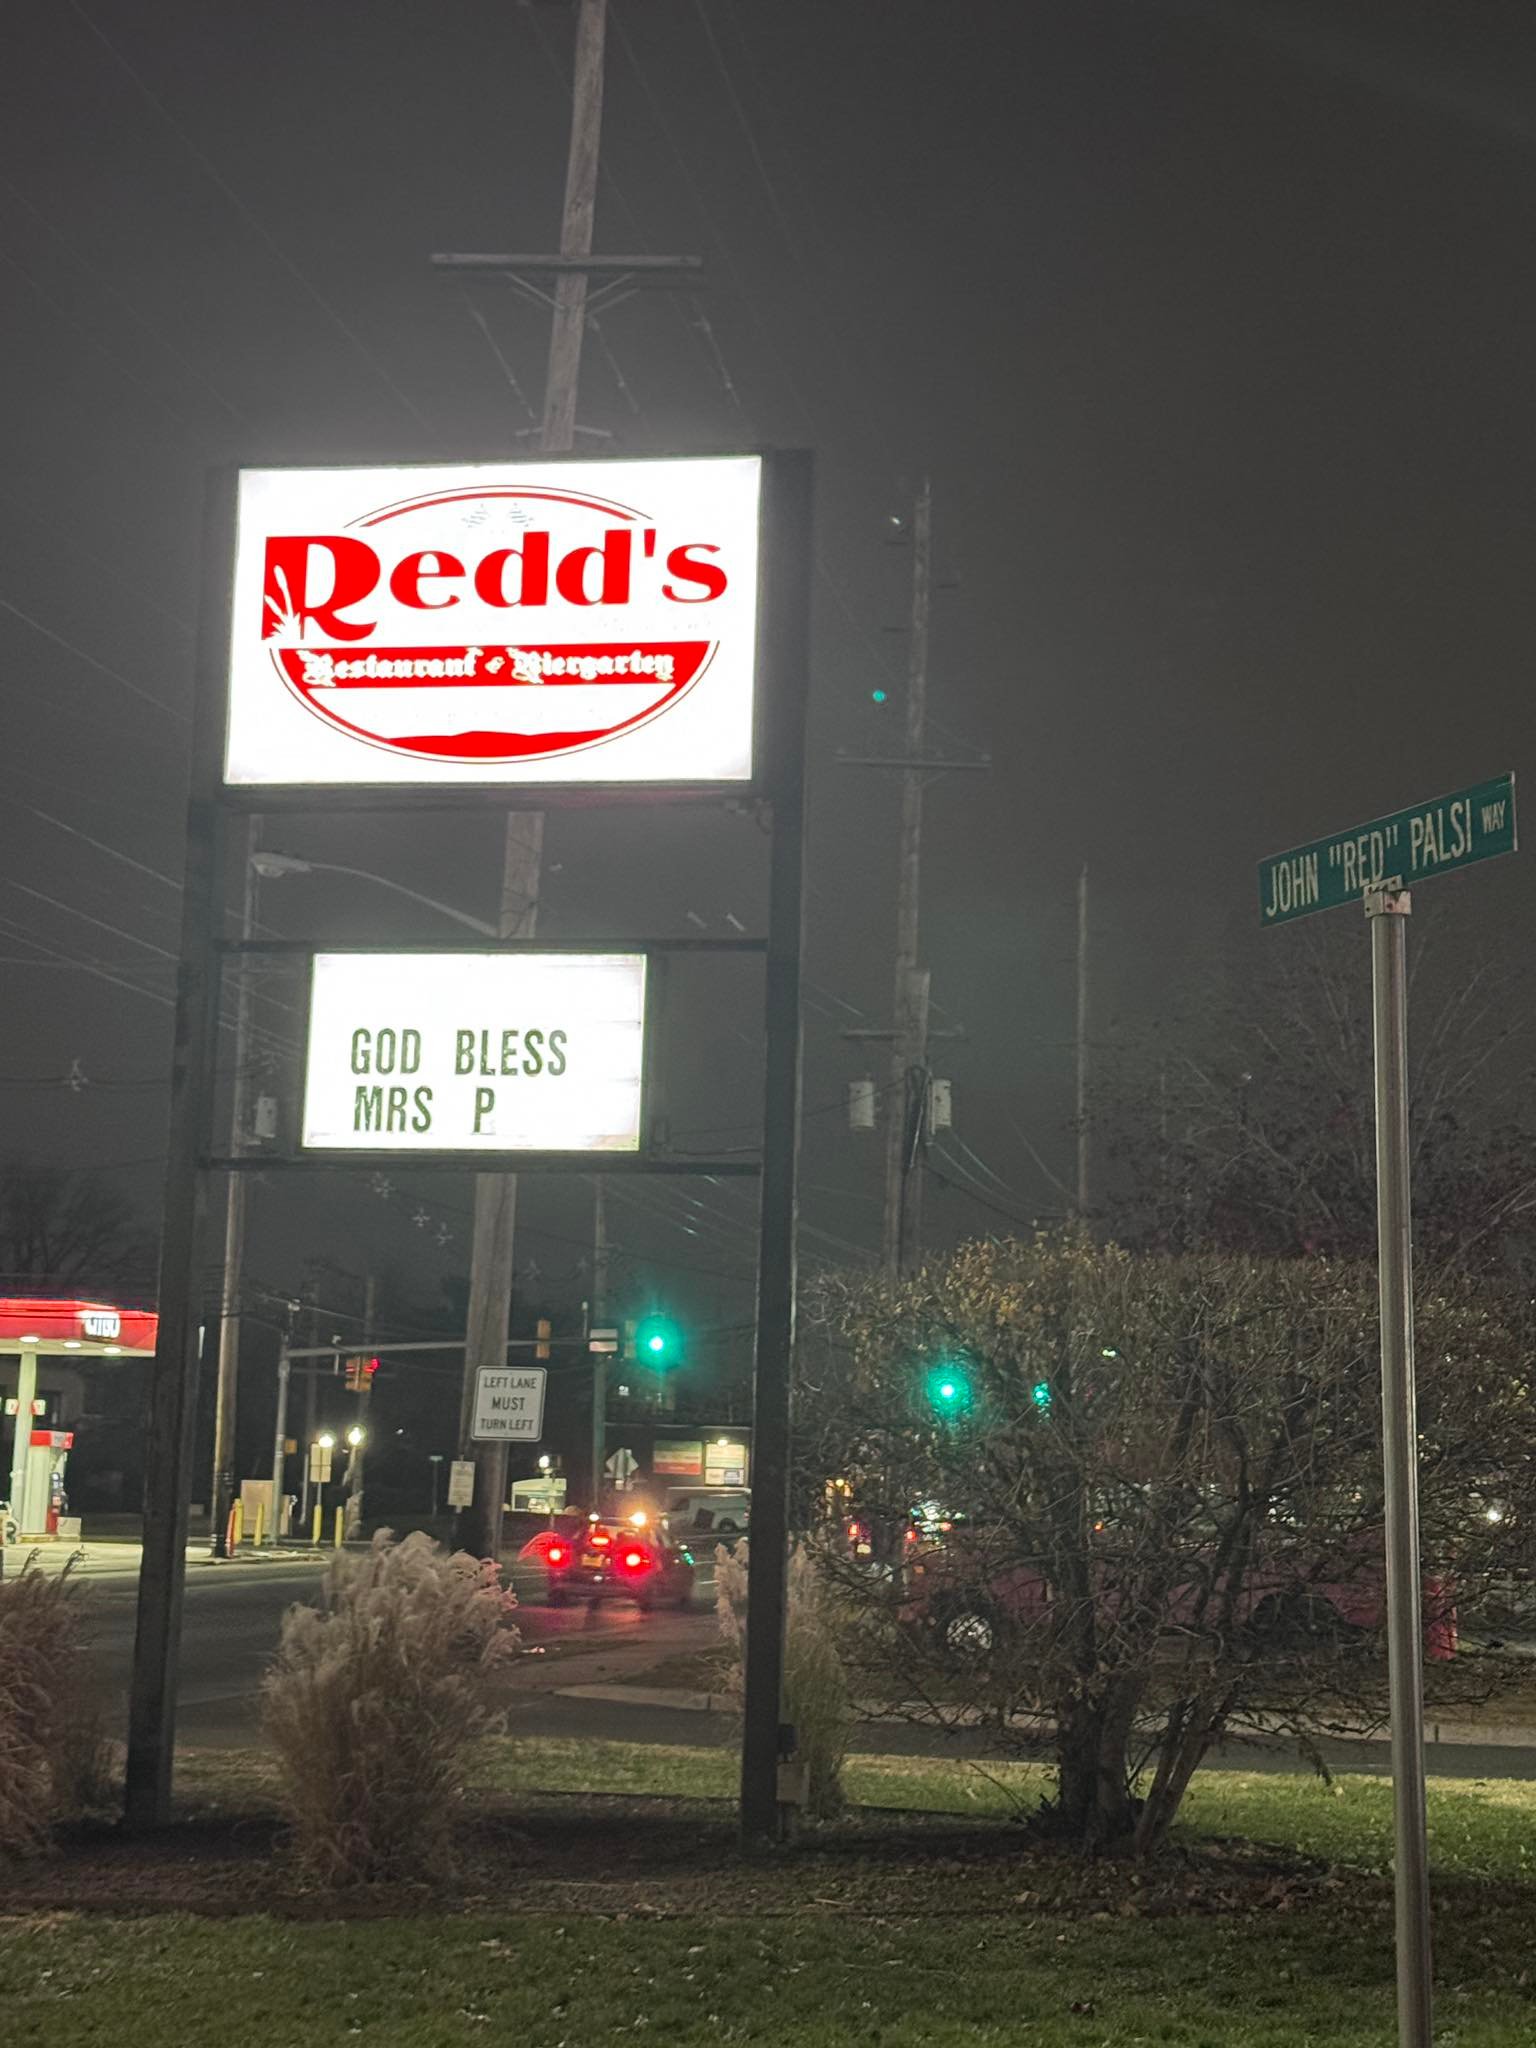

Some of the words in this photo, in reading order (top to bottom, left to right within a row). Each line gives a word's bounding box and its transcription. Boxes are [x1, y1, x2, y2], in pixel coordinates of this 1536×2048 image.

[261, 529, 728, 641] Redd's
[296, 647, 485, 688] Restaurant
[505, 647, 675, 684] Biergarten
[1265, 852, 1320, 917] JOHN
[1328, 823, 1400, 892] "RED"
[1409, 798, 1473, 871] PALSI
[1480, 800, 1506, 834] WAY
[350, 1028, 422, 1076] GOD
[454, 1029, 568, 1077] BLESS
[353, 1085, 434, 1133] MRS
[473, 1086, 496, 1134] P
[483, 1376, 508, 1389] LEFT
[510, 1377, 537, 1389] LANE
[491, 1396, 525, 1411] MUST
[480, 1417, 507, 1430] TURN
[508, 1418, 534, 1431] LEFT
